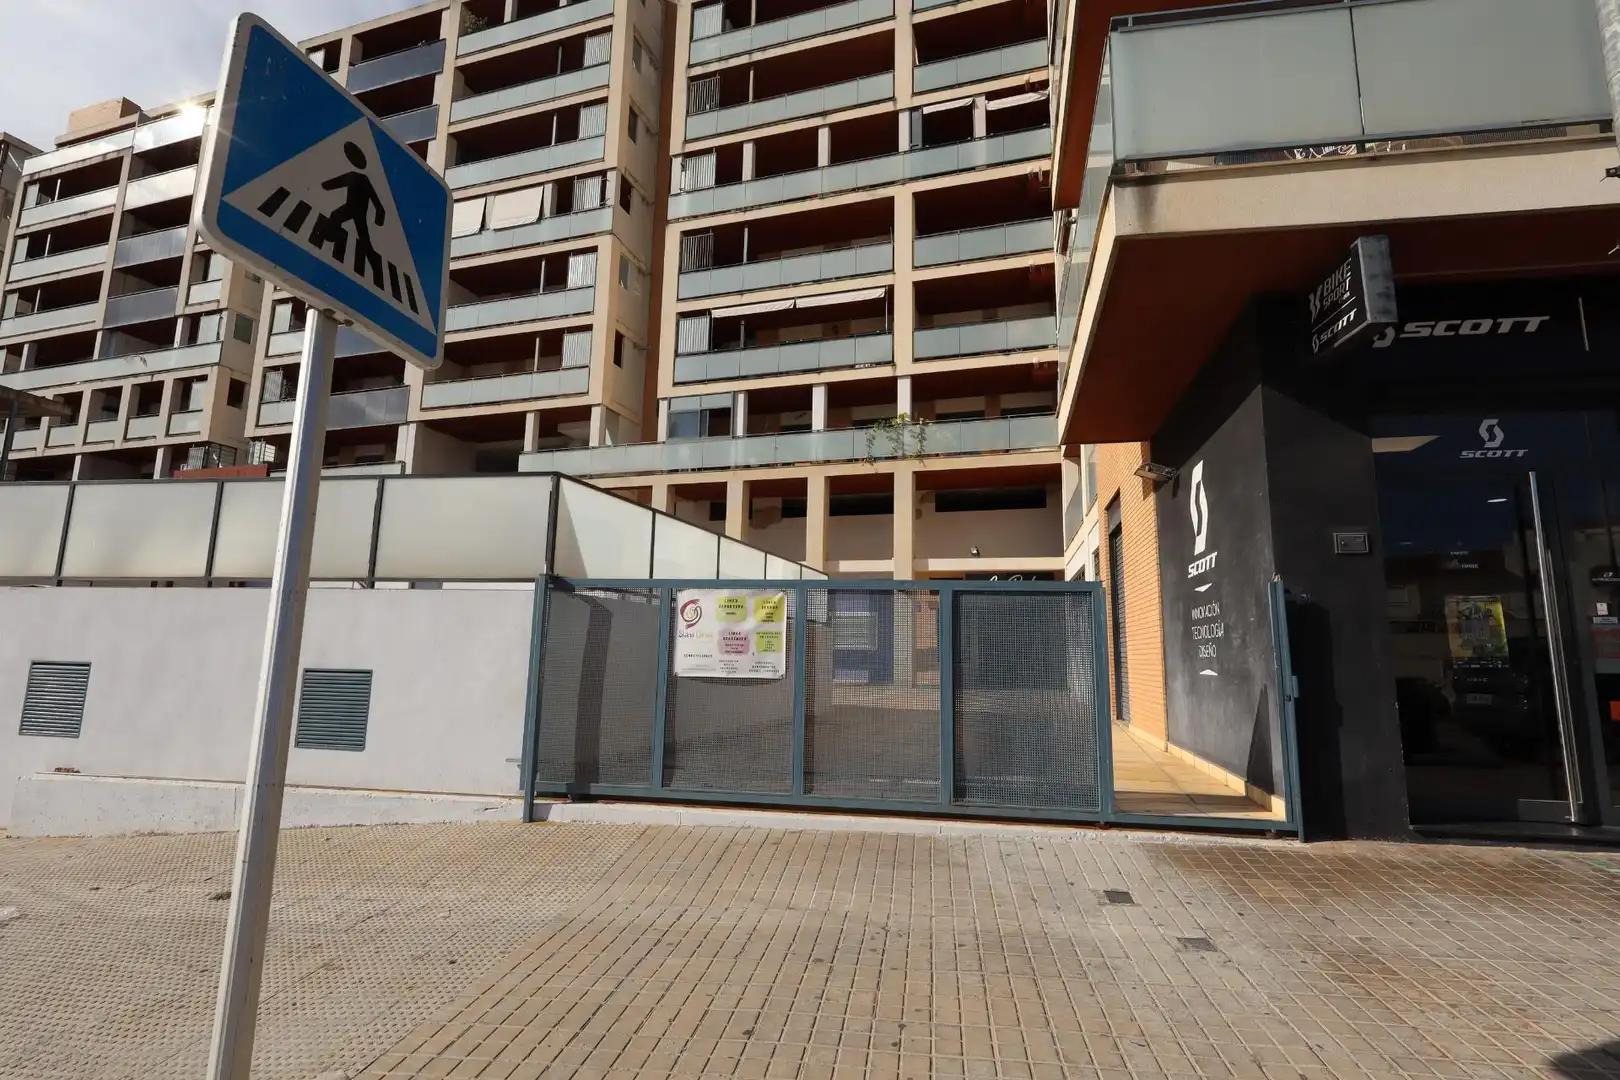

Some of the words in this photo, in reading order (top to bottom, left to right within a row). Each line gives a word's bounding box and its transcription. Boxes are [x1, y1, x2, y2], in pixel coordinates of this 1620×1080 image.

[1323, 257, 1352, 297] BIKE
[1322, 276, 1351, 310] SPORT
[1319, 308, 1357, 344] SCOTT
[1399, 315, 1551, 338] SCOTT
[1459, 449, 1529, 458] SCOTT
[1187, 552, 1218, 578] SCOTT
[1191, 600, 1220, 621] INNOVACIÓN
[1191, 620, 1224, 640] TECNOLOGÍA
[1198, 642, 1217, 658] DISEÑO
